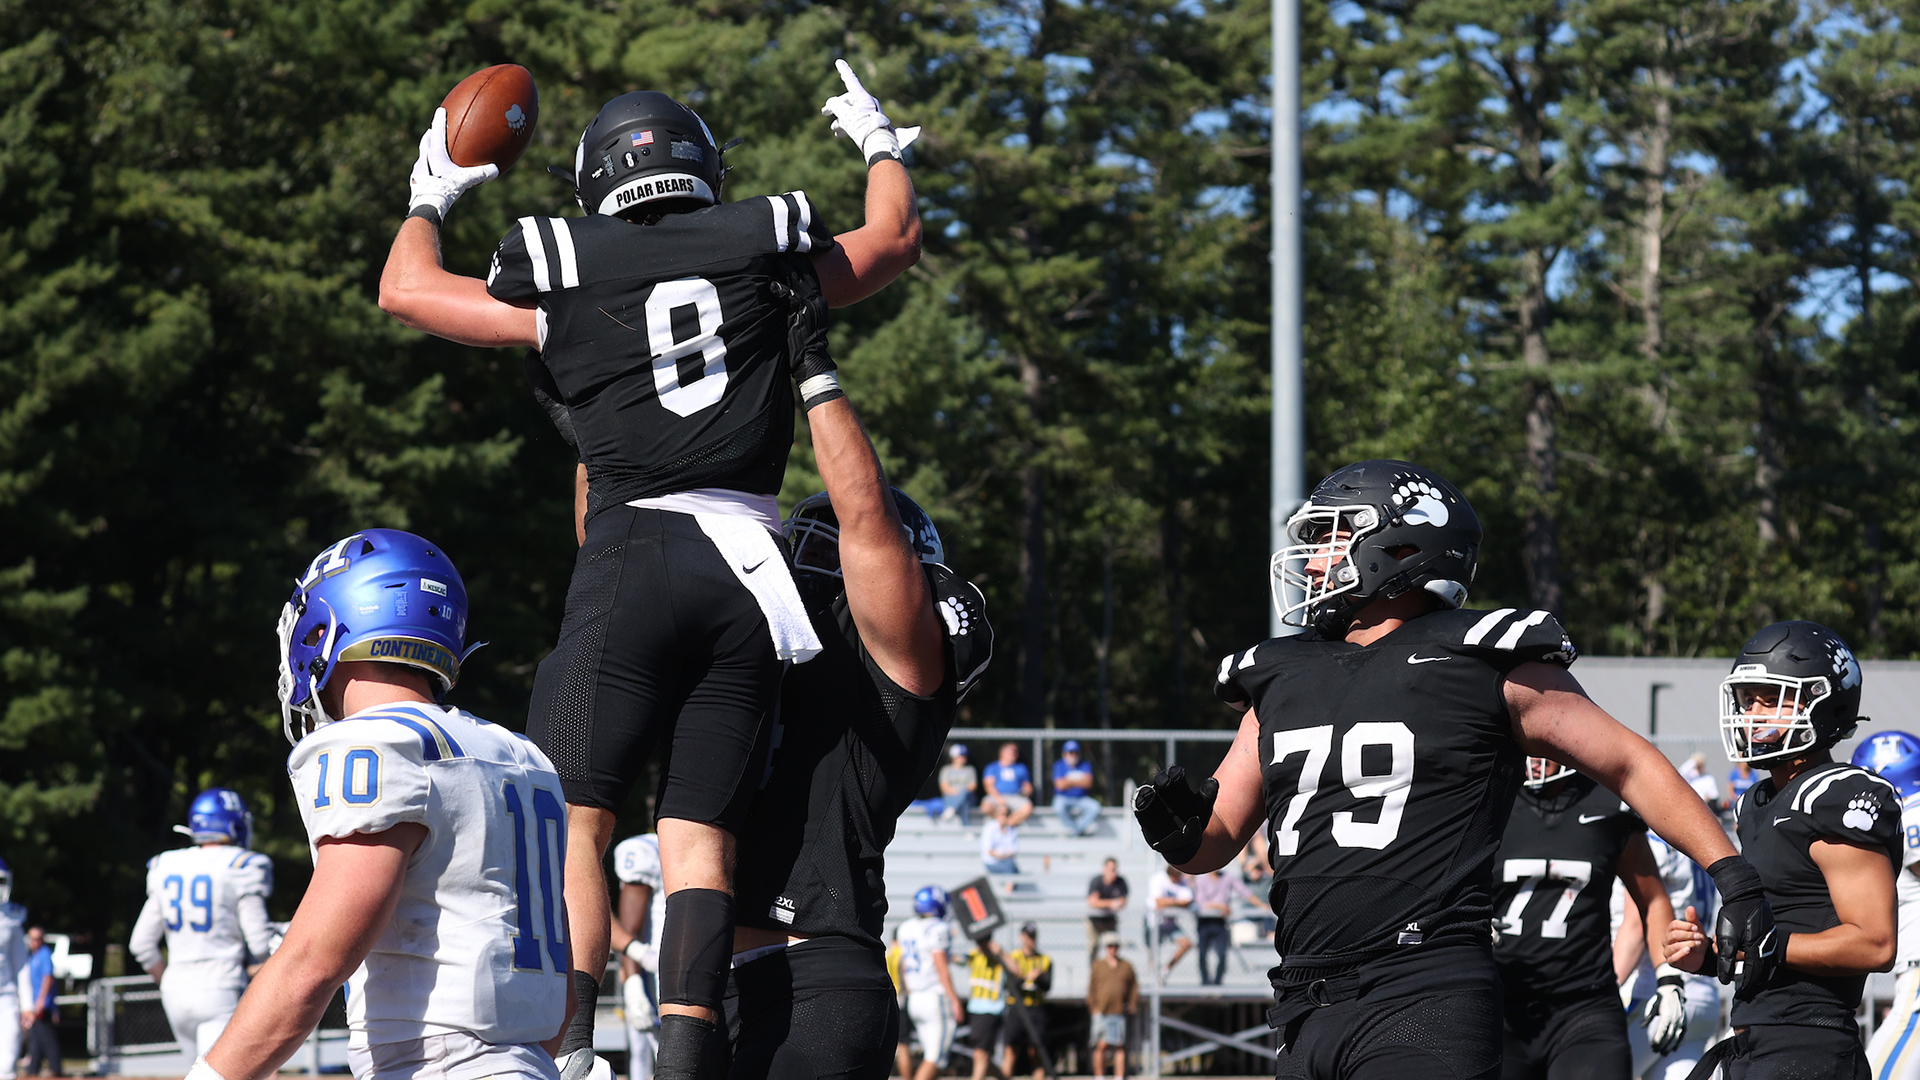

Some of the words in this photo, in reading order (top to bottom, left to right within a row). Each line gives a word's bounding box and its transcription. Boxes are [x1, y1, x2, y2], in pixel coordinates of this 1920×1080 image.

[624, 152, 635, 168] 8
[615, 183, 654, 208] POLAR
[655, 178, 695, 195] BEARS
[644, 275, 729, 419] 8
[441, 605, 452, 620] 10
[1872, 735, 1903, 764] H
[313, 745, 383, 812] 10
[1269, 721, 1415, 856] 79
[624, 851, 636, 870] 6
[501, 779, 567, 977] 10
[163, 874, 213, 932] 39
[774, 896, 796, 910] 2XL
[959, 886, 988, 923] 1
[1503, 859, 1592, 939] 77
[1405, 922, 1421, 931] XL
